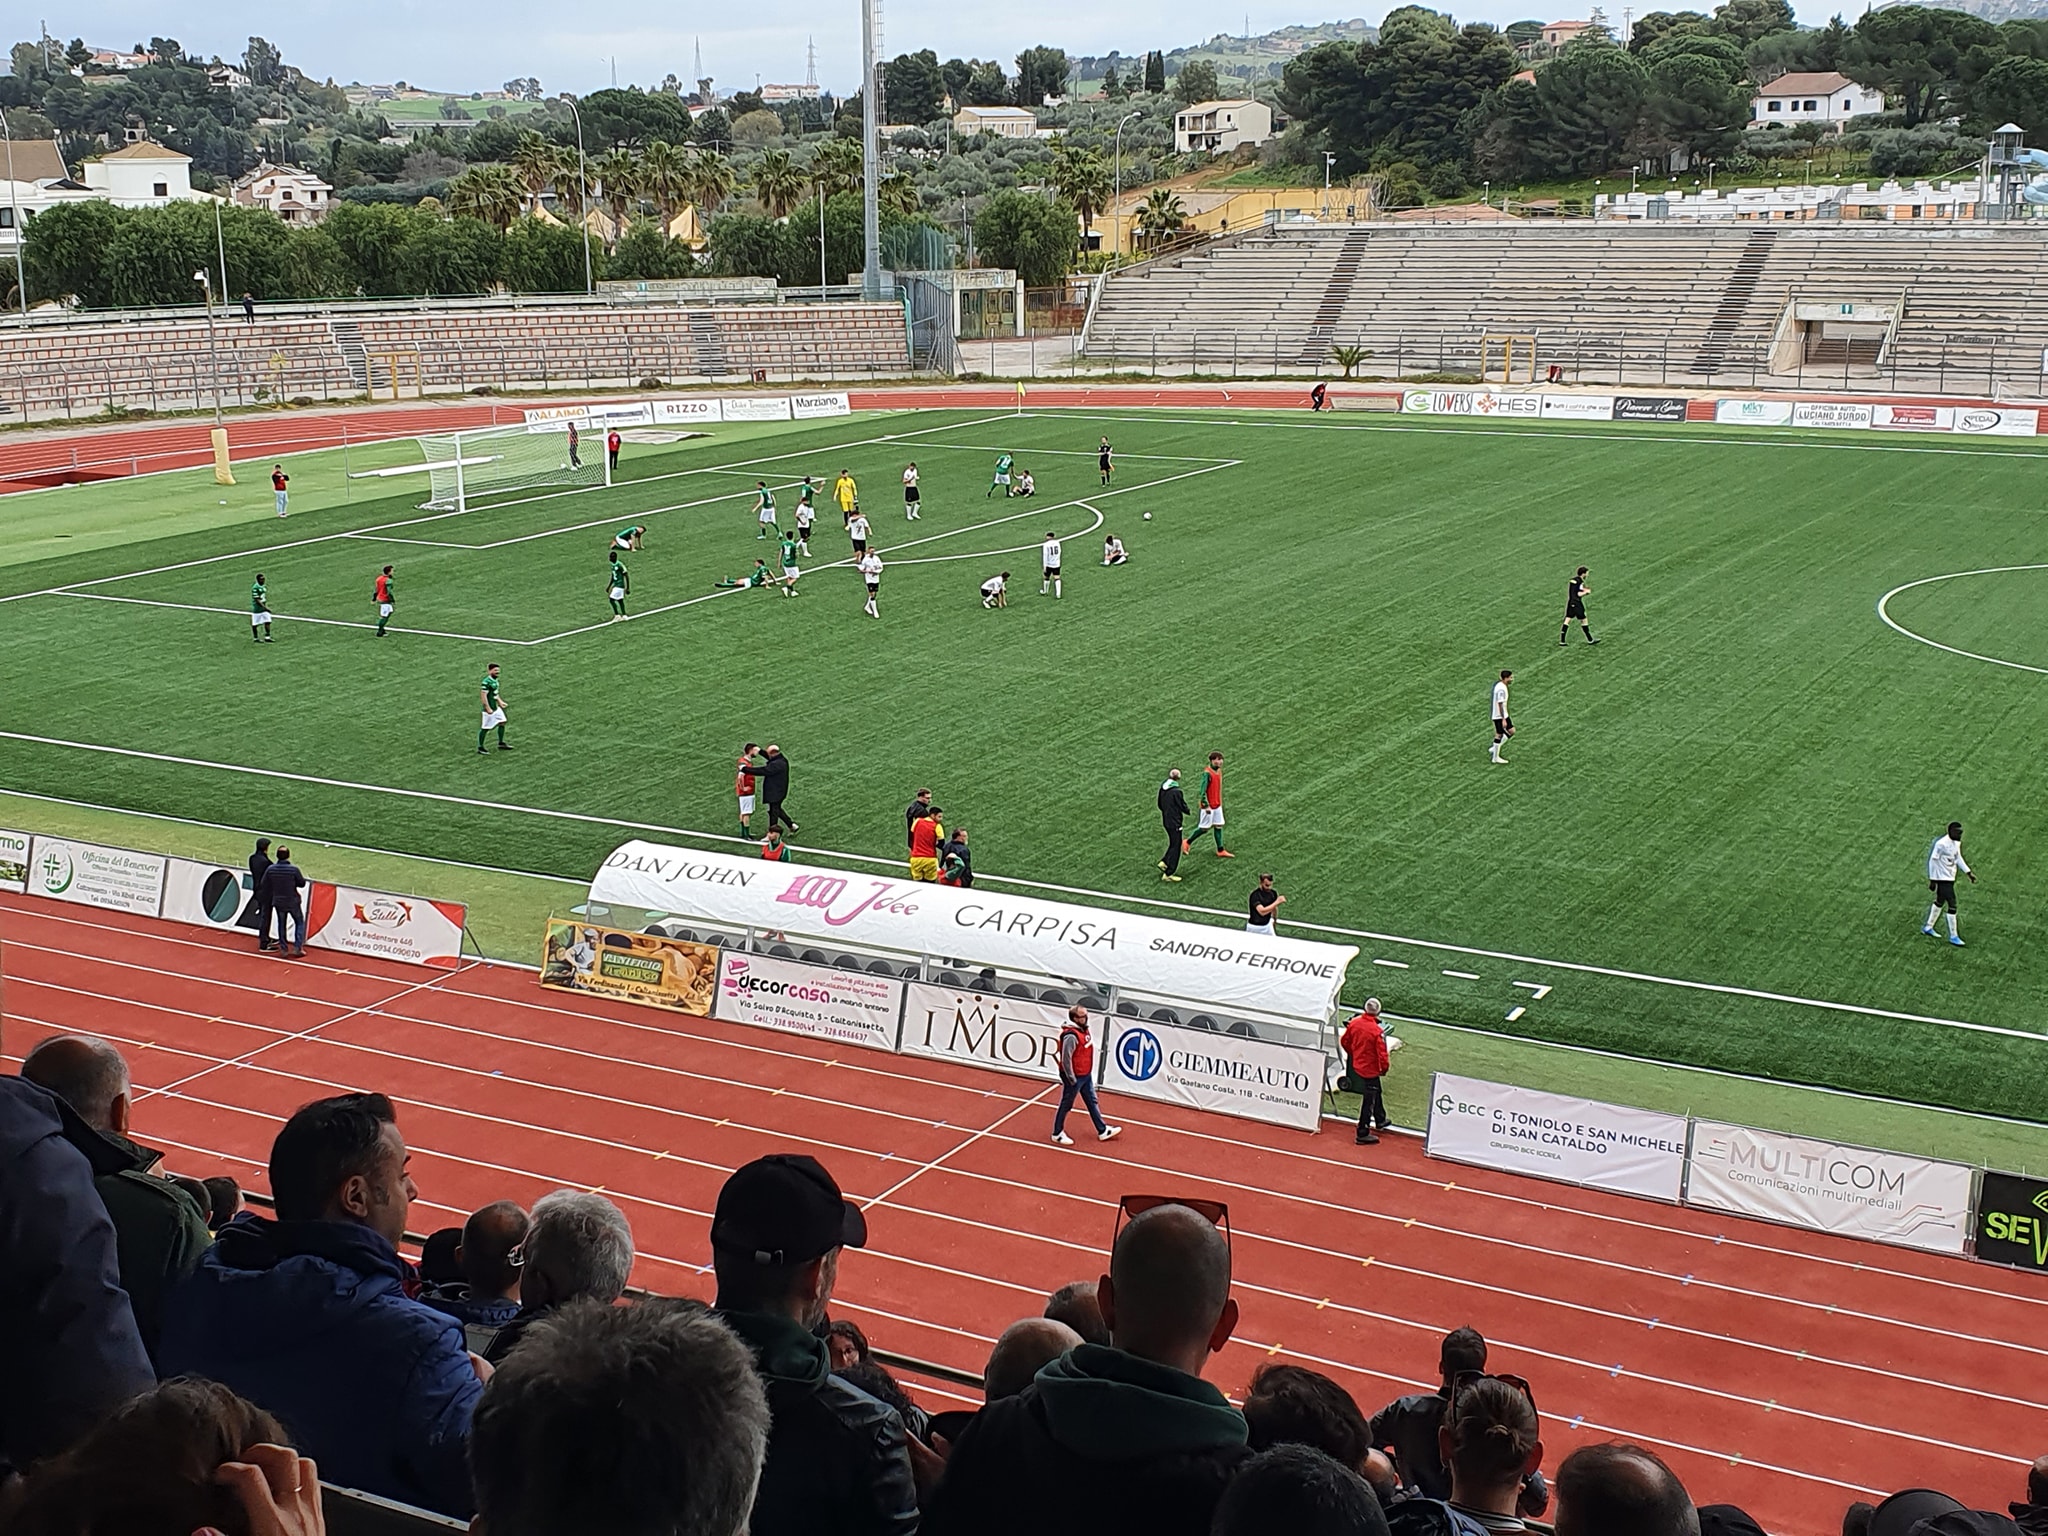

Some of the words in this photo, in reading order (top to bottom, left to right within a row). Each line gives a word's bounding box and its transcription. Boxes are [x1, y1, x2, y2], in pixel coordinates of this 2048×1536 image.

[539, 407, 586, 420] ALAIMO
[666, 403, 708, 414] RIZZO
[795, 395, 839, 408] Marziano
[1432, 392, 1472, 414] LOVERS
[1498, 398, 1538, 411] HES
[1798, 410, 1835, 420] LUCIANO
[604, 851, 670, 876] DAN
[665, 860, 757, 888] JOHN
[349, 928, 361, 937] Via
[362, 930, 399, 944] Redentore
[953, 903, 1119, 951] CARPISA
[341, 937, 372, 950] Telefono
[1148, 937, 1234, 963] SANDRO
[1235, 952, 1338, 980] FERRONE
[738, 974, 831, 1004] decorcasa
[739, 999, 751, 1009] Via
[753, 1001, 774, 1013] Salvo
[830, 1015, 885, 1033] Caltanissetta
[922, 1009, 937, 1048] I
[945, 1007, 1062, 1068] MOR
[1169, 1049, 1310, 1092] GIEMMEAUTO
[1166, 1074, 1179, 1083] Via
[1180, 1077, 1211, 1090] Gaetano
[1212, 1084, 1237, 1096] Costa,
[1259, 1092, 1310, 1109] Caltanissetta
[1458, 1101, 1486, 1117] BCC
[1492, 1109, 1507, 1121] G.
[1509, 1111, 1572, 1133] TONIOLO
[1575, 1125, 1585, 1136] E
[1587, 1127, 1617, 1142] SAN
[1620, 1132, 1685, 1155] MICHELE
[1492, 1122, 1506, 1135] DI
[1509, 1126, 1538, 1141] SAN
[1541, 1132, 1608, 1154] CATALDO
[1489, 1141, 1520, 1152] GRUPPO
[1728, 1140, 1905, 1197] MULTICOM
[1727, 1169, 1820, 1198] Comunicazioni
[1822, 1188, 1903, 1211] multimediali
